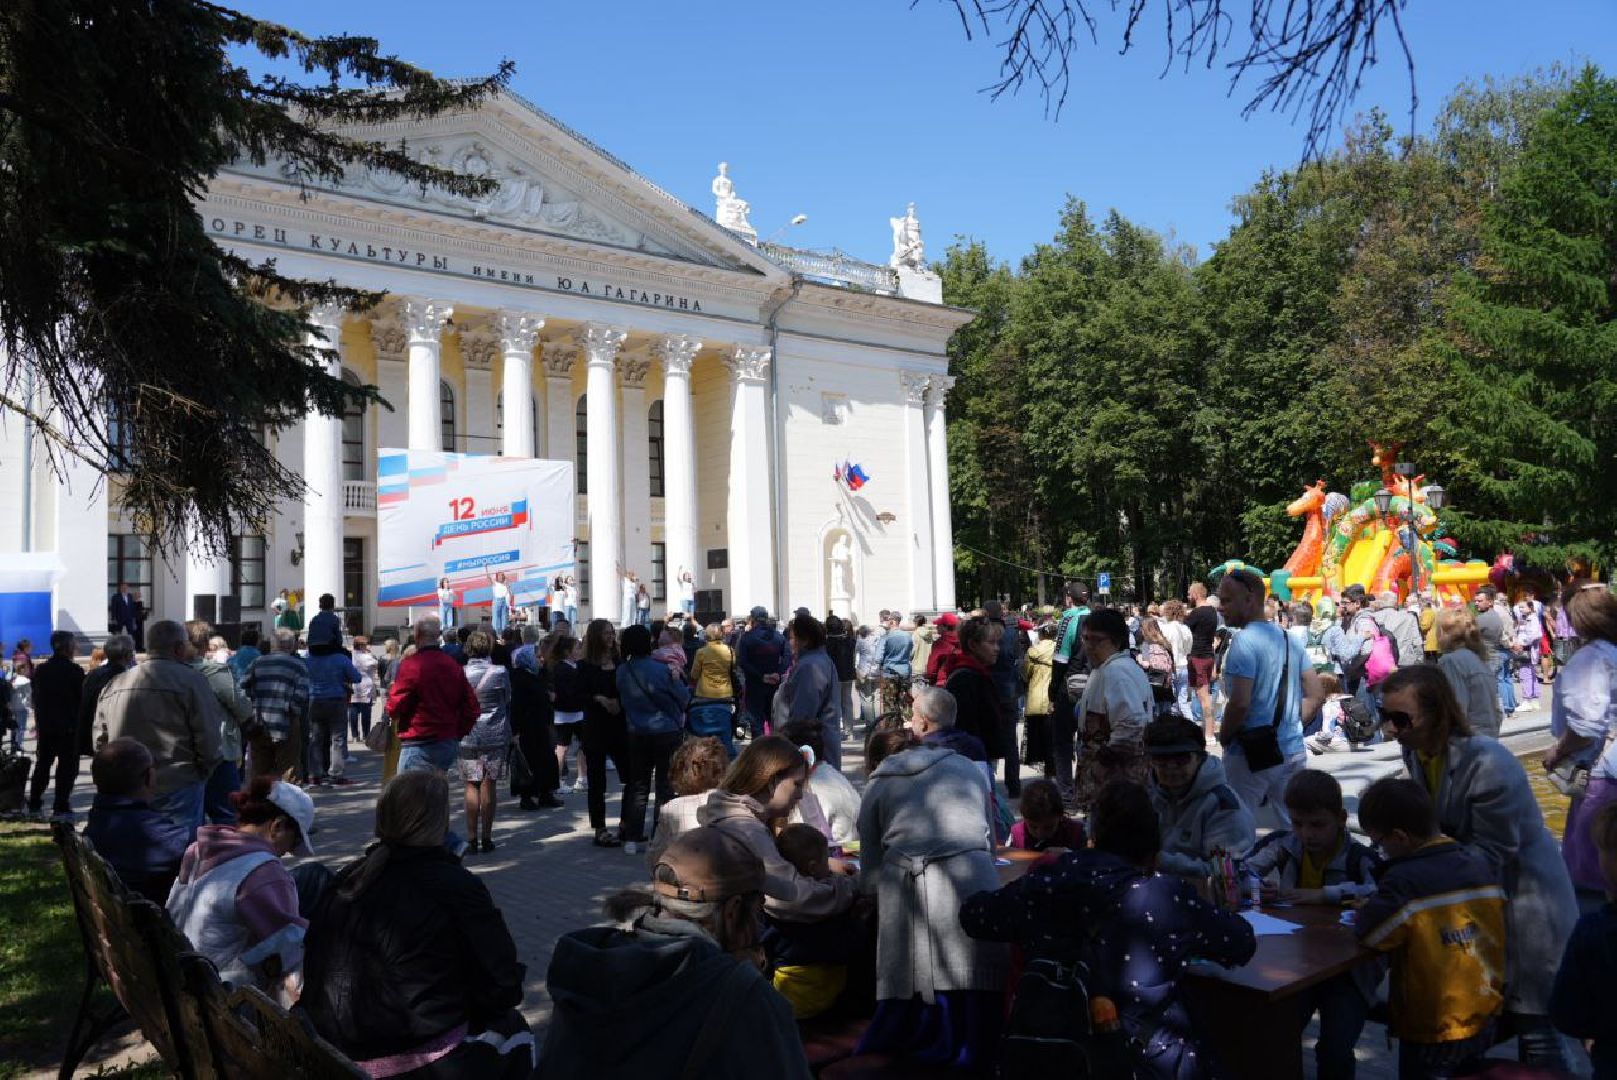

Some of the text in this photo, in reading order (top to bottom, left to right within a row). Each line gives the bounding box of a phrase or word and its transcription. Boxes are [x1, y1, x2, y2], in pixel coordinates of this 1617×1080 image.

[212, 218, 288, 243] ОРЕЦ
[310, 234, 448, 270] КУЛЬТУРЫ
[472, 265, 535, 284] ИМЕНИ
[604, 284, 702, 311] ГАГАРИНА
[448, 497, 510, 521] 12 ИЮНЯ
[443, 517, 509, 534] ДЕНЬ РОССИИ
